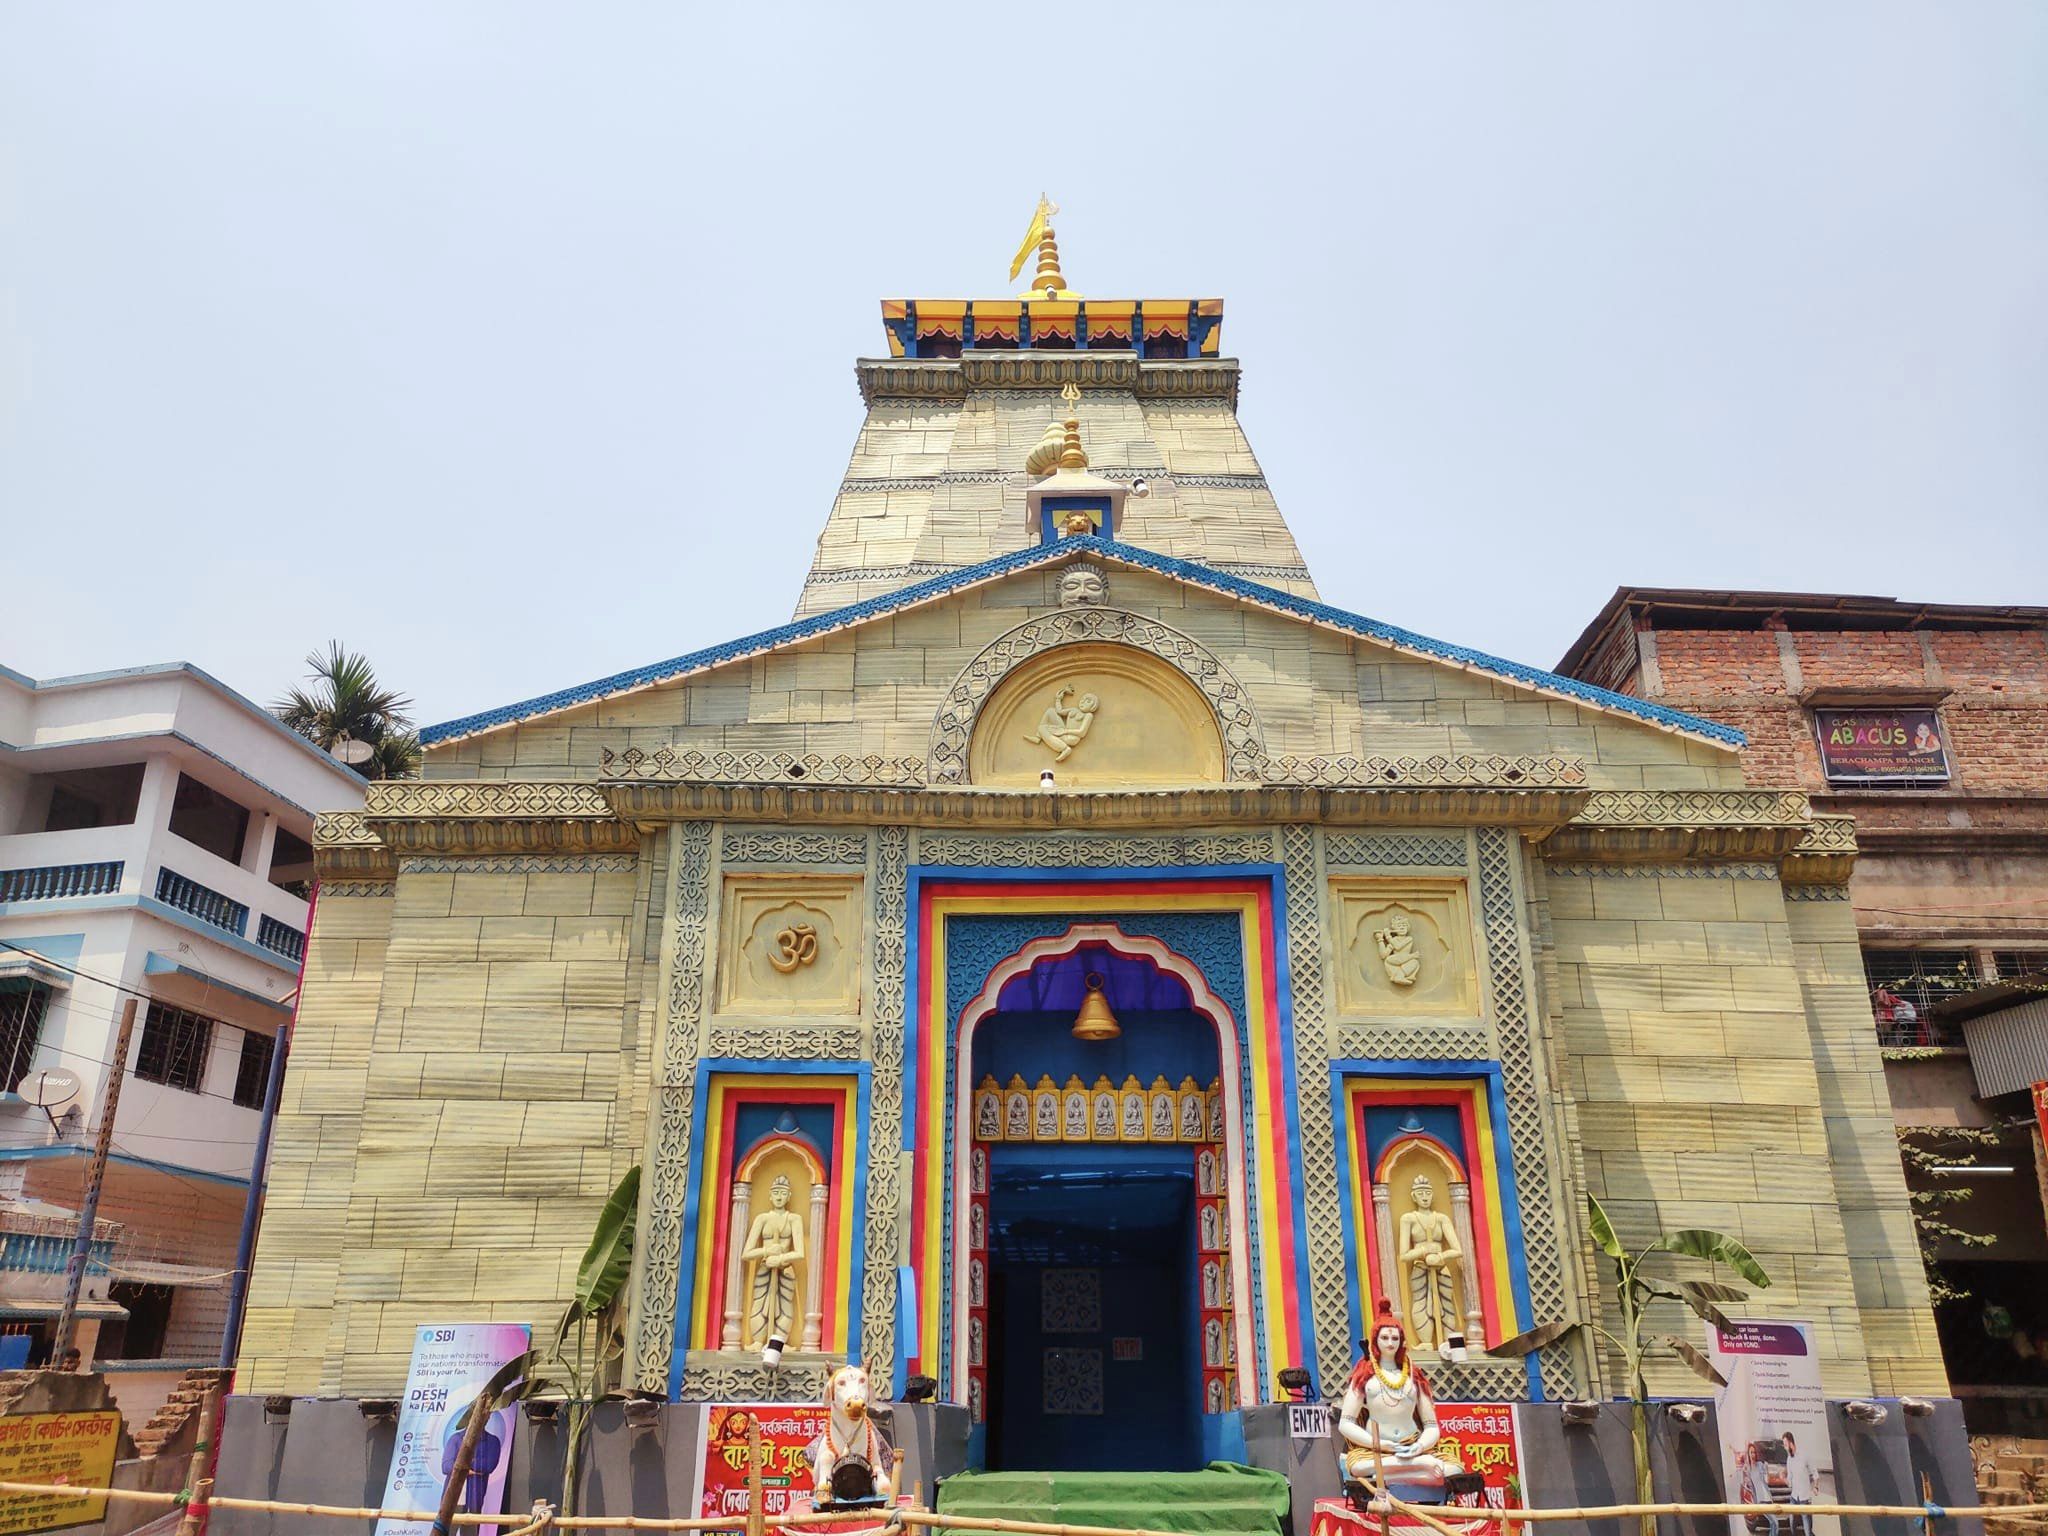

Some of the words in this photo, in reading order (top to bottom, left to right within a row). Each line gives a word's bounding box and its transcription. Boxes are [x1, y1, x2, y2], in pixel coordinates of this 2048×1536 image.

[1830, 727, 1908, 745] ABACUS
[435, 1330, 455, 1342] SBI
[430, 1352, 448, 1360] those
[436, 1370, 453, 1378] your
[411, 1389, 448, 1401] DESH
[409, 1402, 420, 1410] ka
[421, 1401, 446, 1412] FAN
[1293, 1409, 1327, 1432] ENTRY
[1465, 1443, 1514, 1474] পুজো
